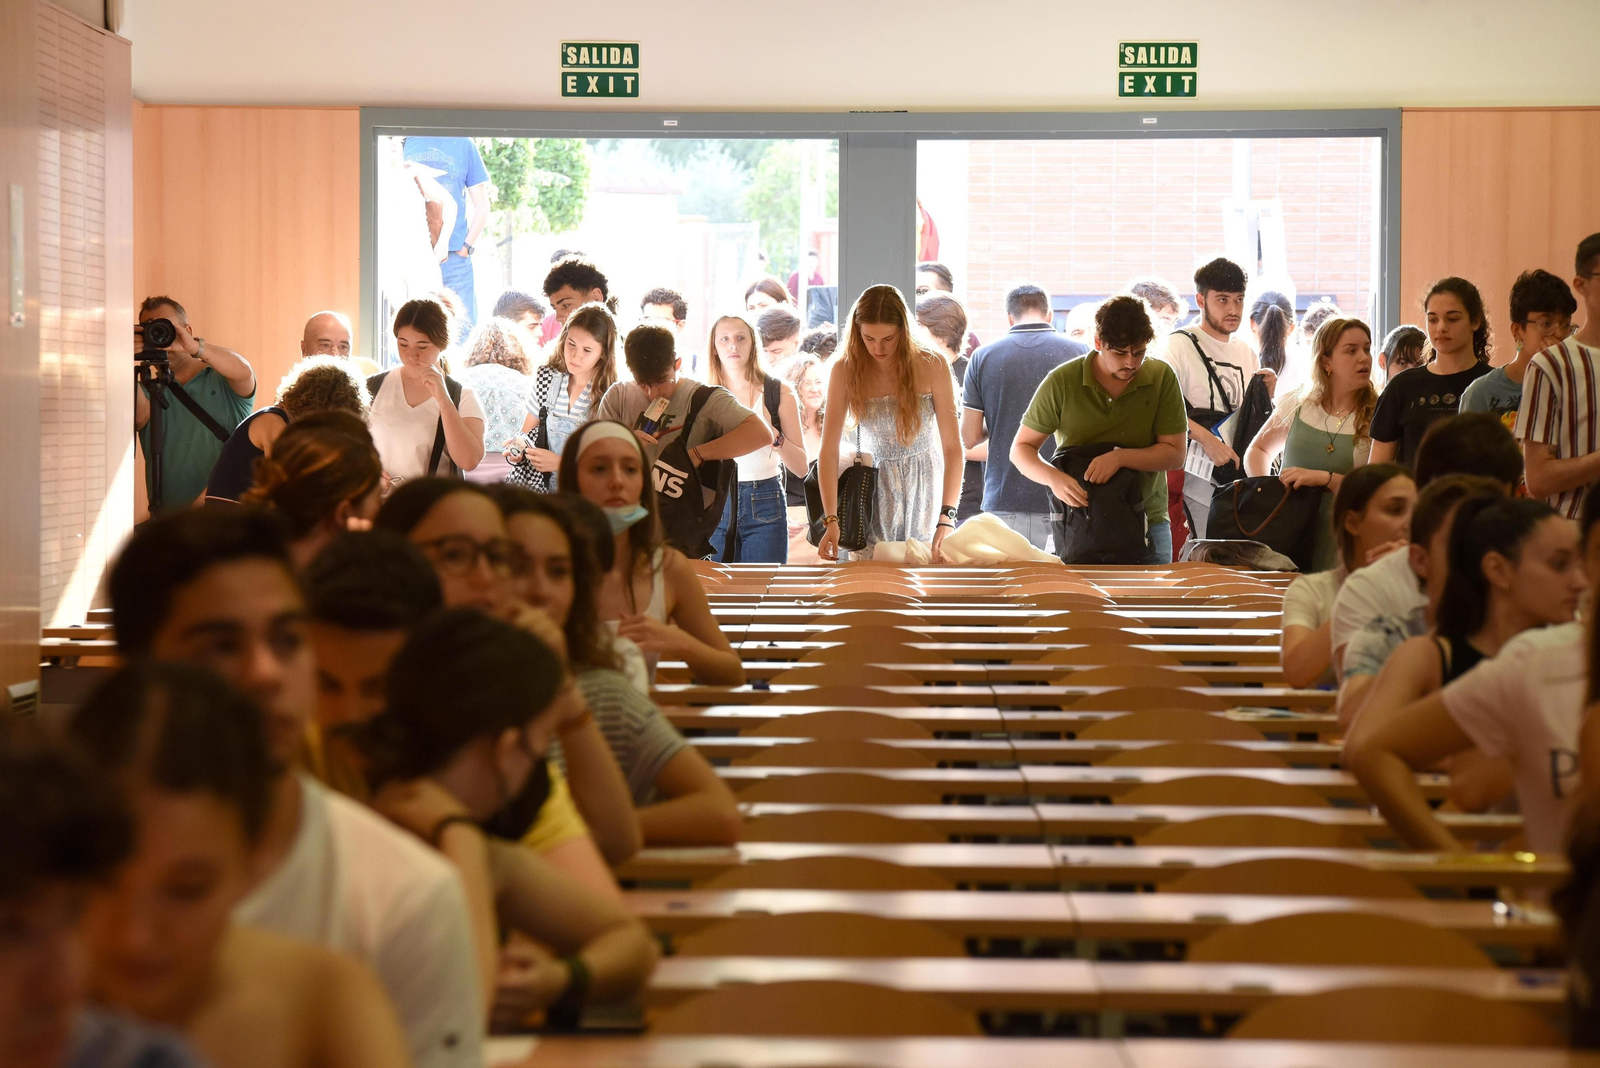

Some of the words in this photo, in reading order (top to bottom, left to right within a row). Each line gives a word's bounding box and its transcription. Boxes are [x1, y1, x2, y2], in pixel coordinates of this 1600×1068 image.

[567, 46, 633, 64] SALIDA
[1124, 46, 1192, 64] SALIDA
[566, 75, 635, 93] EXIT
[1124, 75, 1193, 93] EXIT
[651, 459, 688, 498] NS
